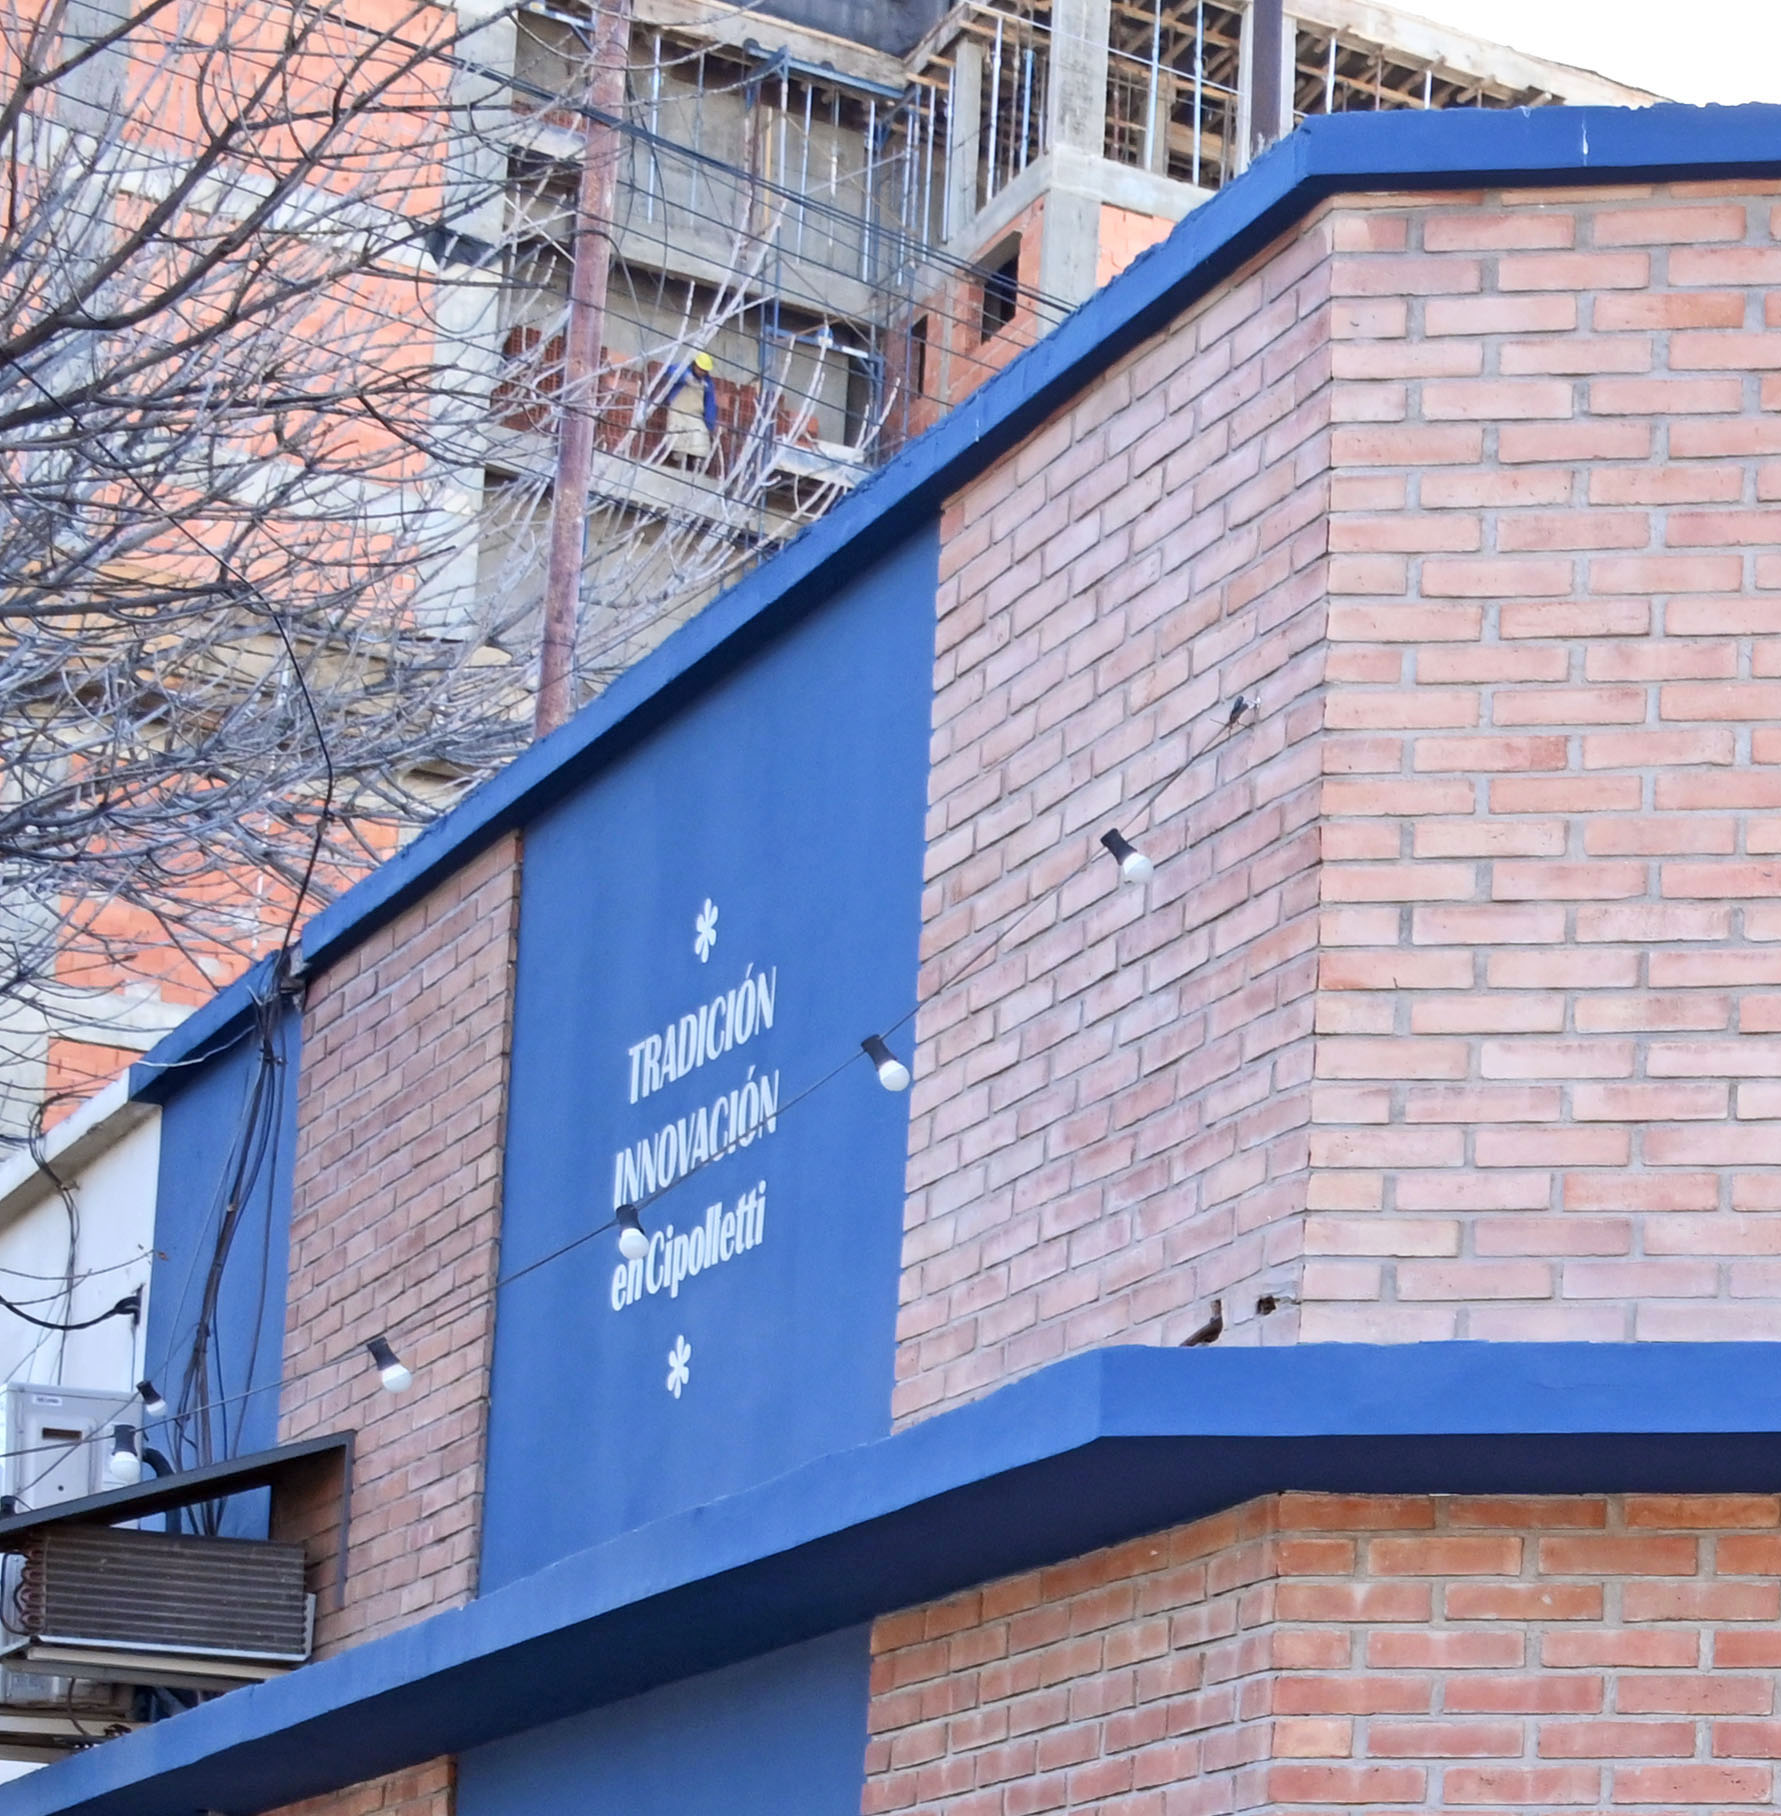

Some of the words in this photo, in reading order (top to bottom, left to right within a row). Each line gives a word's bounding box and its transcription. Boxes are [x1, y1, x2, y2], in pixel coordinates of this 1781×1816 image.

[628, 963, 777, 1104] TRADICIÓN
[613, 1065, 779, 1211] INNOVACIÓN
[611, 1254, 644, 1312] en
[646, 1180, 767, 1299] Cipolletti
